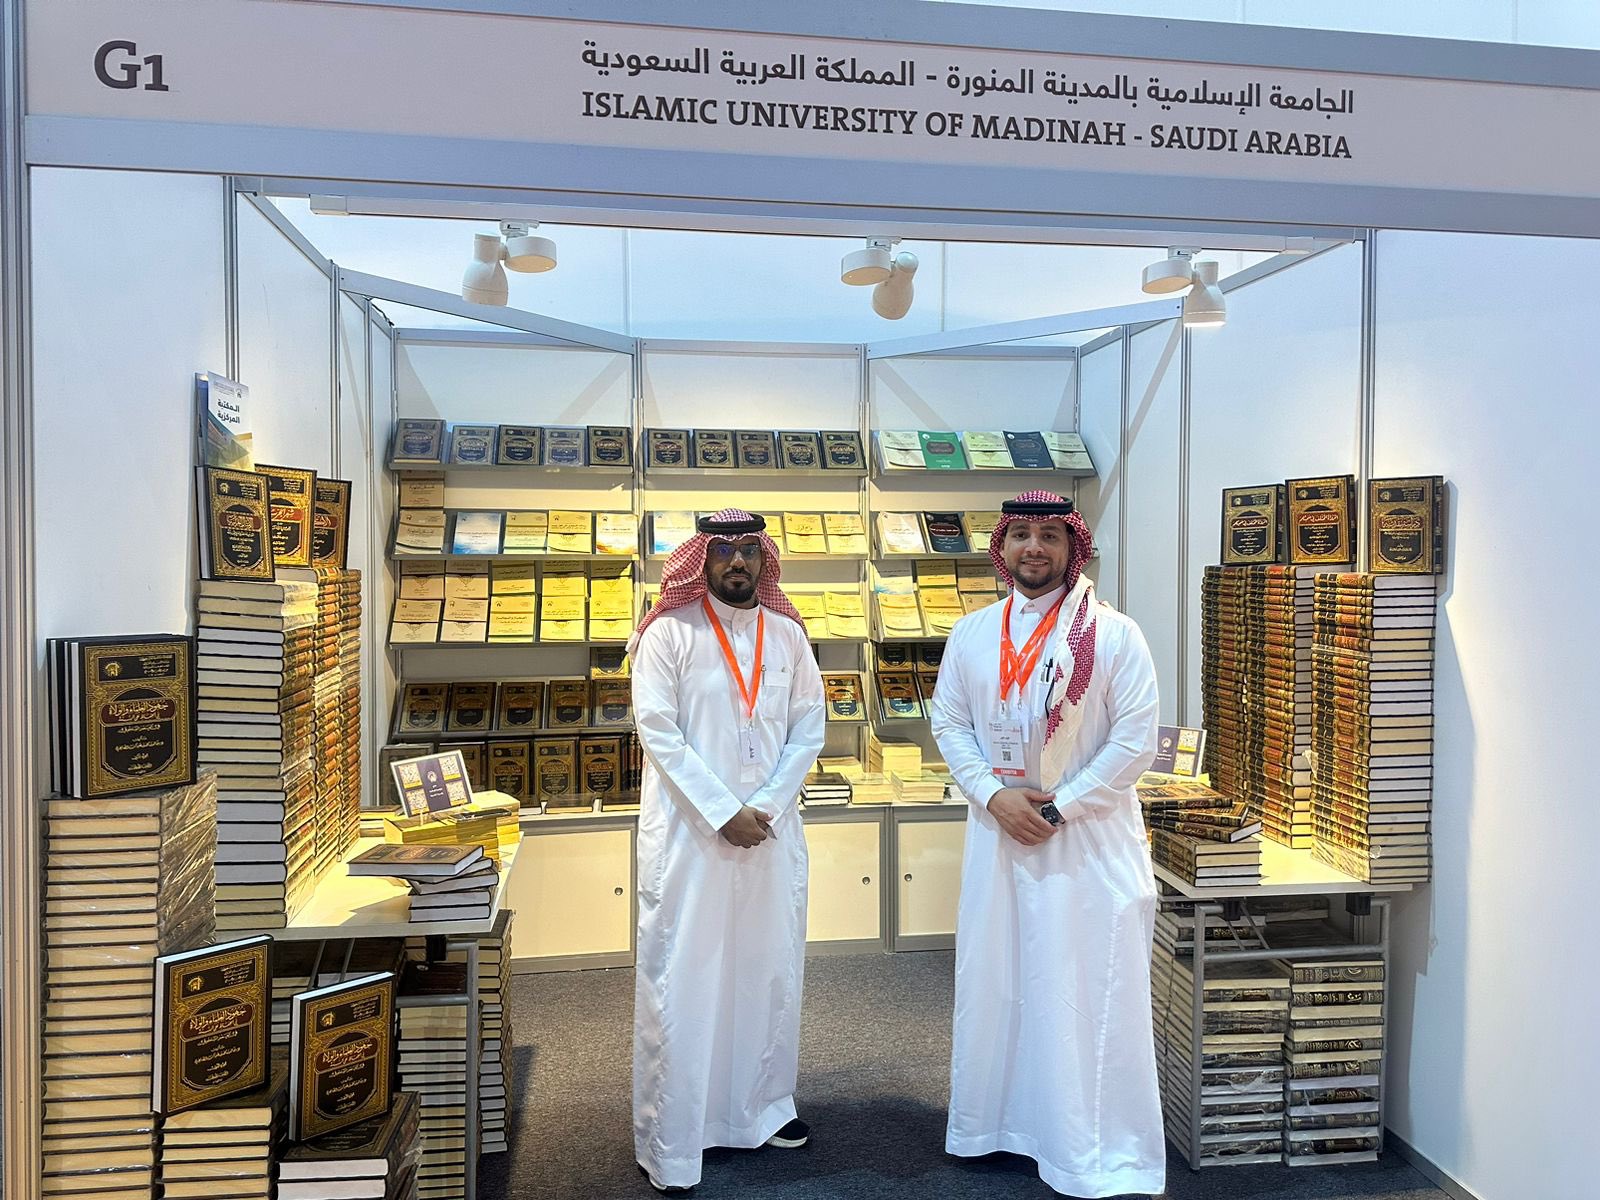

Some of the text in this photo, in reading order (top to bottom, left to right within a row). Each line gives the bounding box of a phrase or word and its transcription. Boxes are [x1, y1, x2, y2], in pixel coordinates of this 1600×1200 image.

[94, 39, 170, 92] G1
[581, 40, 709, 76] السعودية
[720, 50, 805, 85] العربية
[815, 56, 915, 87] المملكة
[947, 65, 1034, 97] المنورة
[1043, 70, 1138, 108] بالمدينة
[1147, 77, 1261, 115] الإسلامية
[1269, 83, 1353, 120] الجامعة
[582, 91, 718, 125] ISLAMIC
[726, 100, 918, 136] UNIVERSITY
[925, 111, 963, 138] OF
[971, 114, 1126, 146] MADINAH
[1150, 124, 1239, 153] SAUDI
[1244, 130, 1352, 159] ARABIA
[216, 410, 241, 424] المركزية
